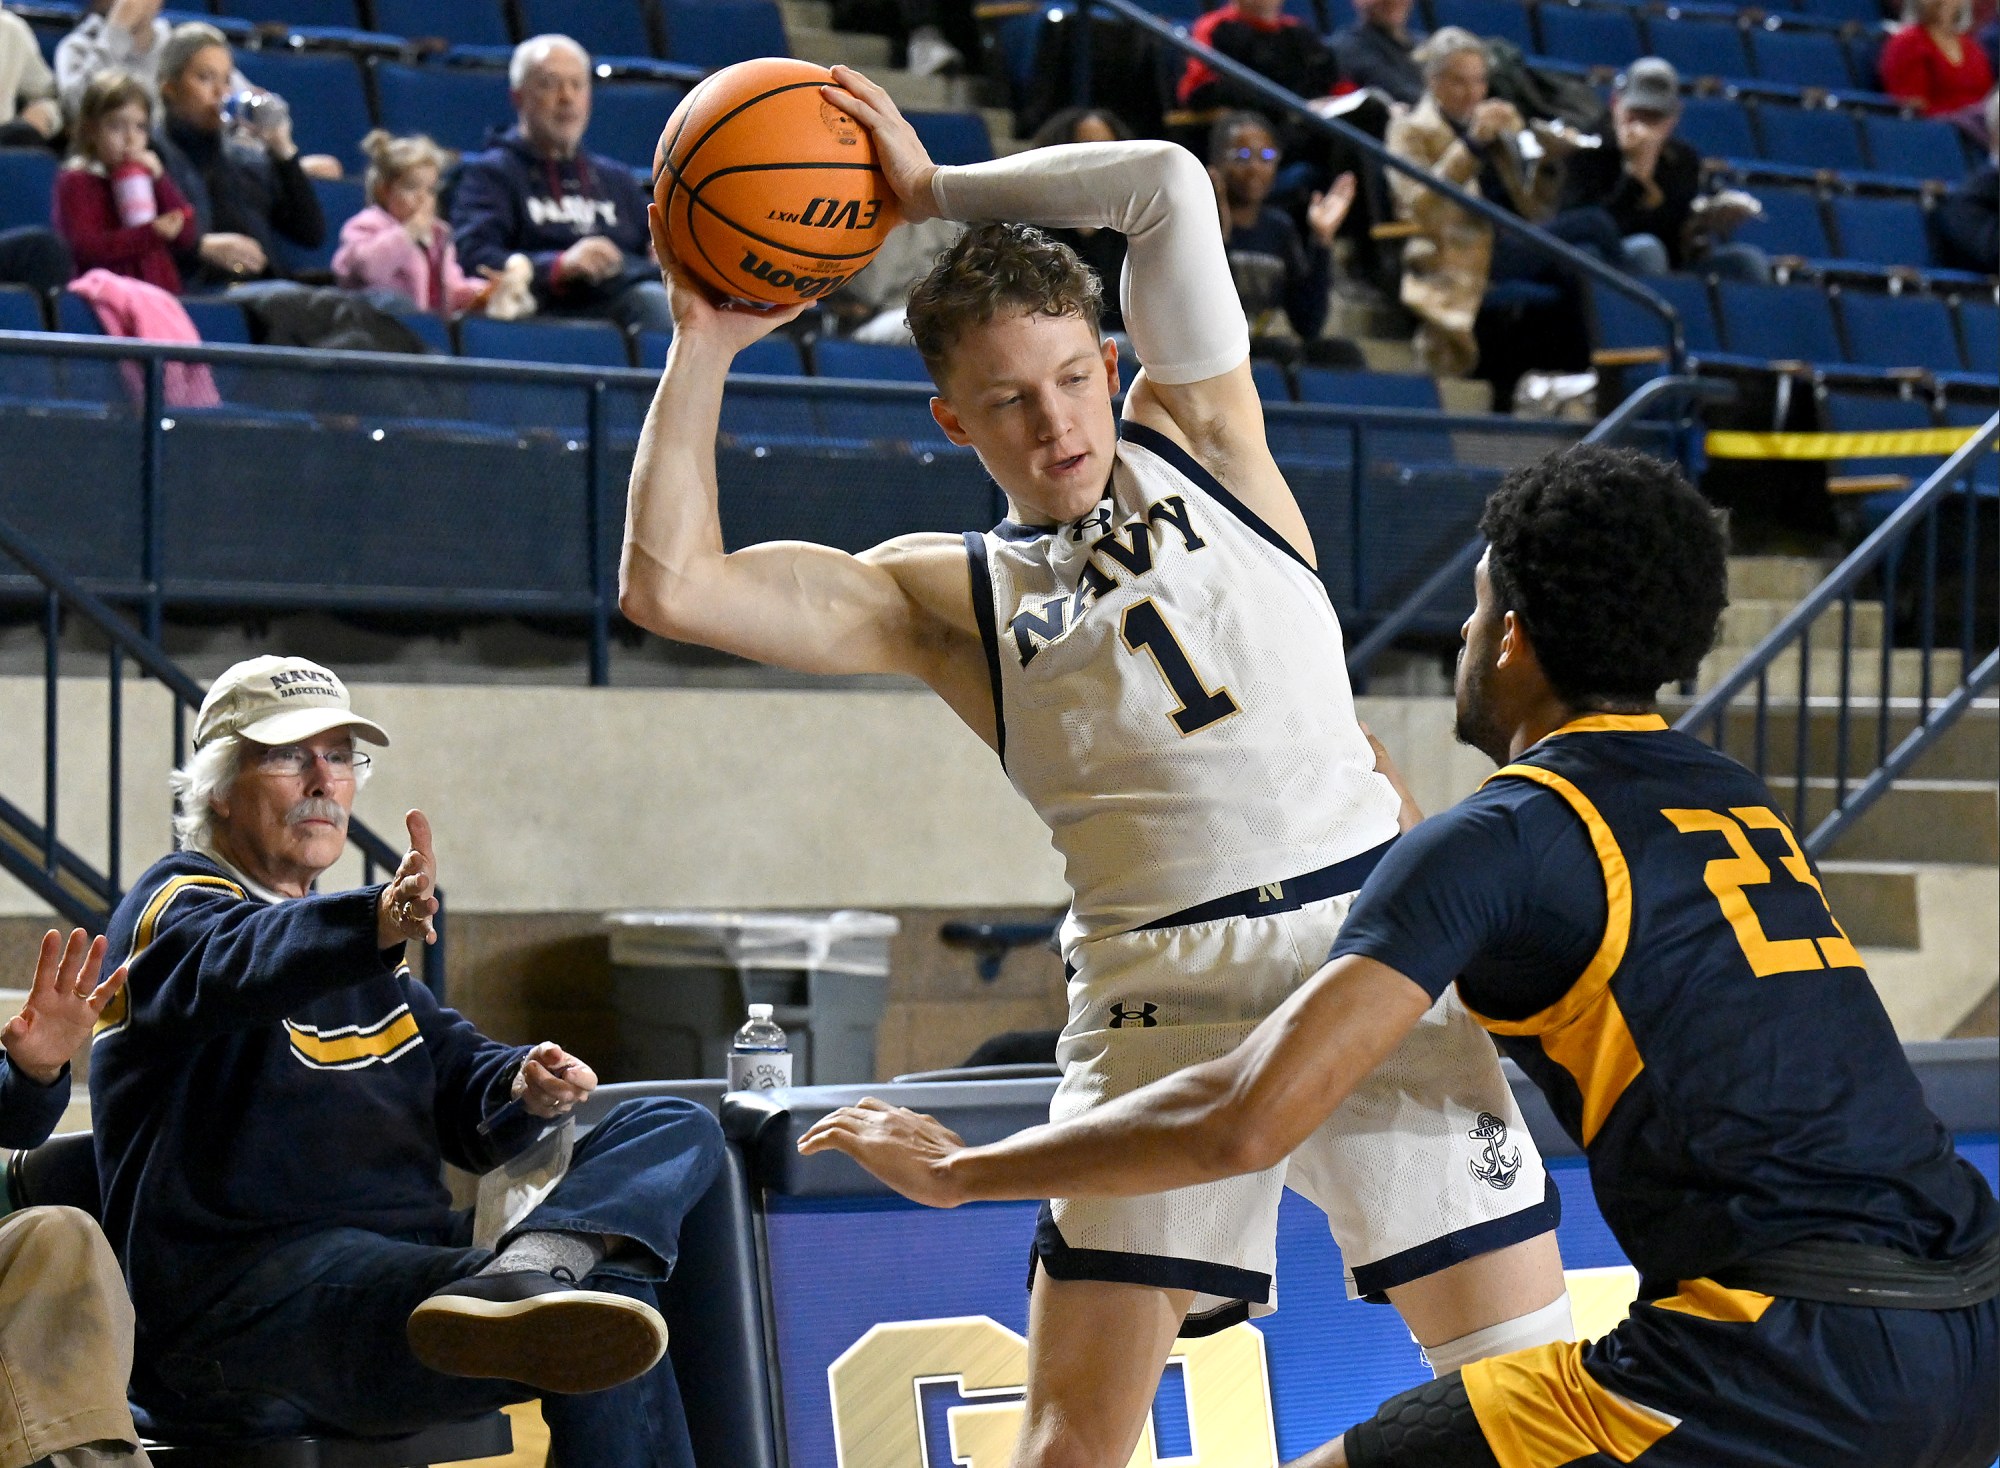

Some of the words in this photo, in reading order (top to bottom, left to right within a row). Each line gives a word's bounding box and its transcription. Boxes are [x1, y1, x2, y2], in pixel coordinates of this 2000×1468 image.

[764, 210, 799, 223] NXT
[799, 197, 883, 229] EVO
[1009, 494, 1209, 672] NAVY
[1119, 595, 1243, 738] 1
[269, 669, 335, 689] NAVY
[280, 686, 341, 699] BASKETBALL
[1258, 881, 1284, 903] N
[1659, 806, 1867, 978] 23
[1475, 1124, 1501, 1138] NAVY
